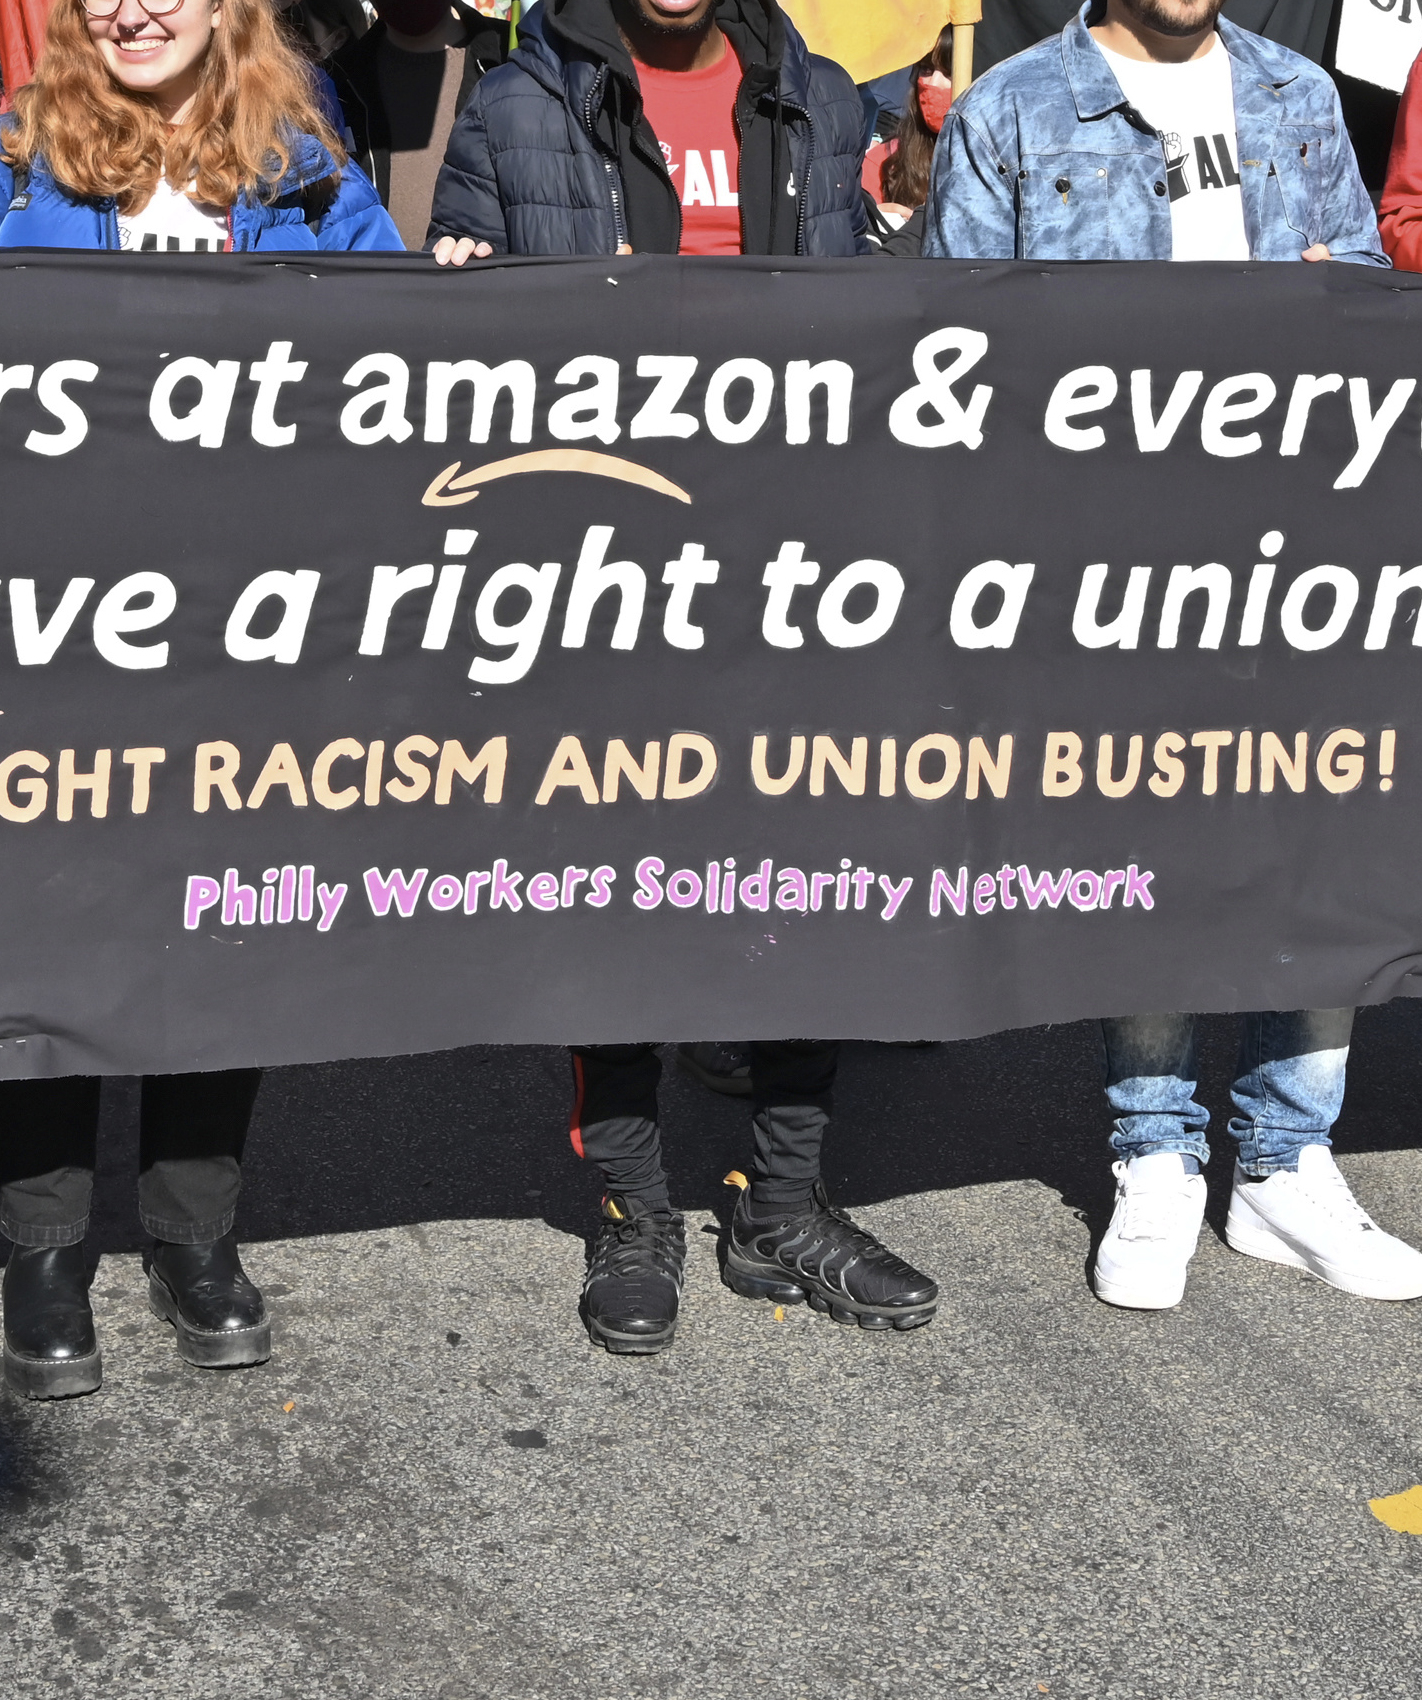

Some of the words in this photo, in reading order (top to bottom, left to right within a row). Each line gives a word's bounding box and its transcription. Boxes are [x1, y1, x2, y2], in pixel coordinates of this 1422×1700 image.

[681, 149, 739, 206] AL
[1193, 132, 1241, 191] AL
[149, 341, 309, 448] at
[339, 352, 854, 446] amazon
[888, 326, 994, 450] &
[224, 569, 321, 666] a
[357, 525, 720, 686] right
[761, 541, 905, 651] to
[949, 562, 1036, 651] a
[191, 735, 508, 813] RACISM
[535, 733, 717, 806] AND
[750, 733, 1014, 800] UNION
[1040, 728, 1397, 799] BUSTING!
[183, 864, 347, 931] Philly
[364, 857, 613, 917] Workers
[633, 855, 912, 921] Solidarity
